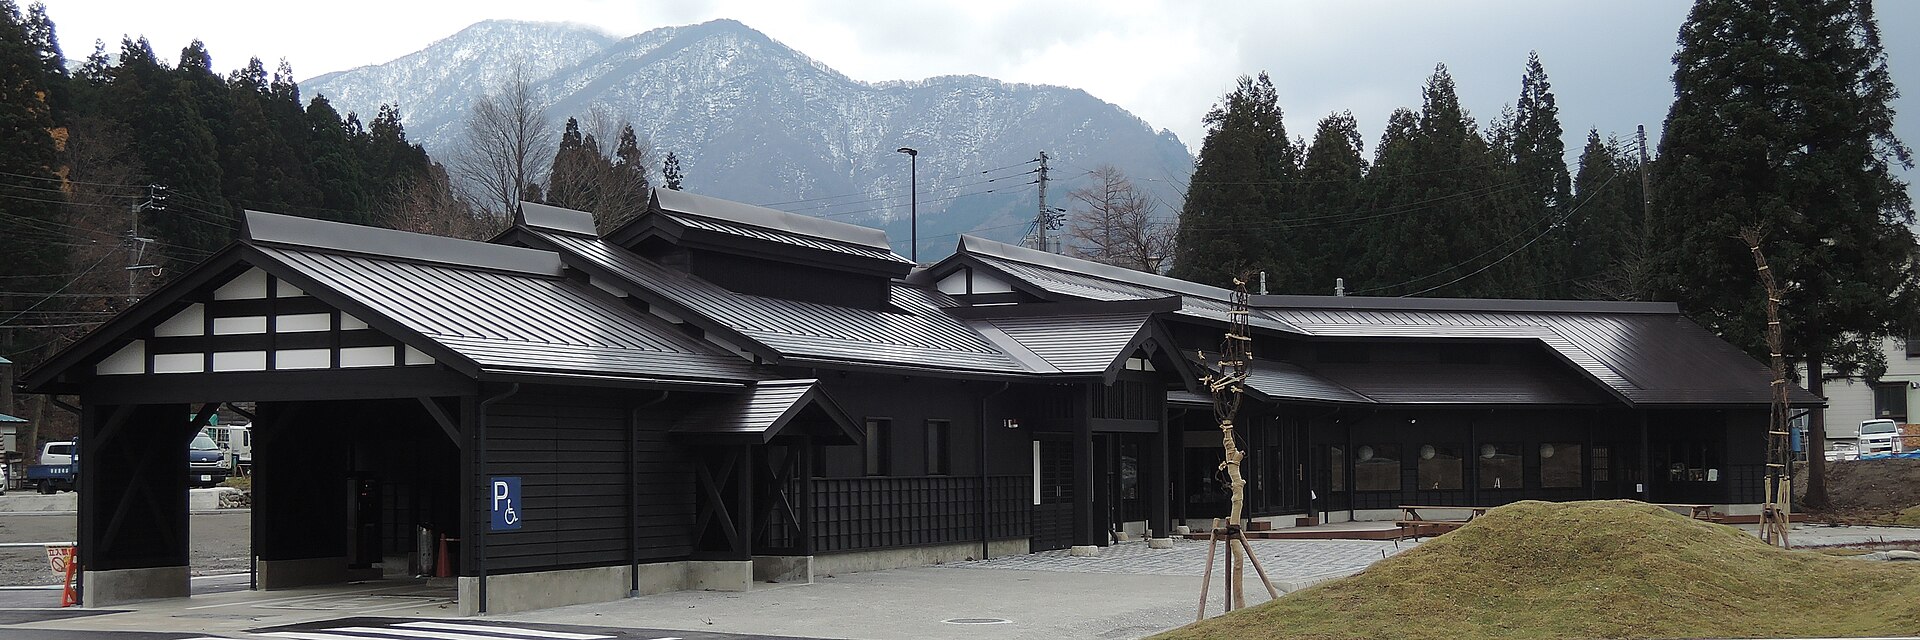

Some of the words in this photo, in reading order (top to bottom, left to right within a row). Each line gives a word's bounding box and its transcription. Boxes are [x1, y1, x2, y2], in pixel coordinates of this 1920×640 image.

[494, 481, 509, 511] P
[48, 548, 71, 556] 立入禁
